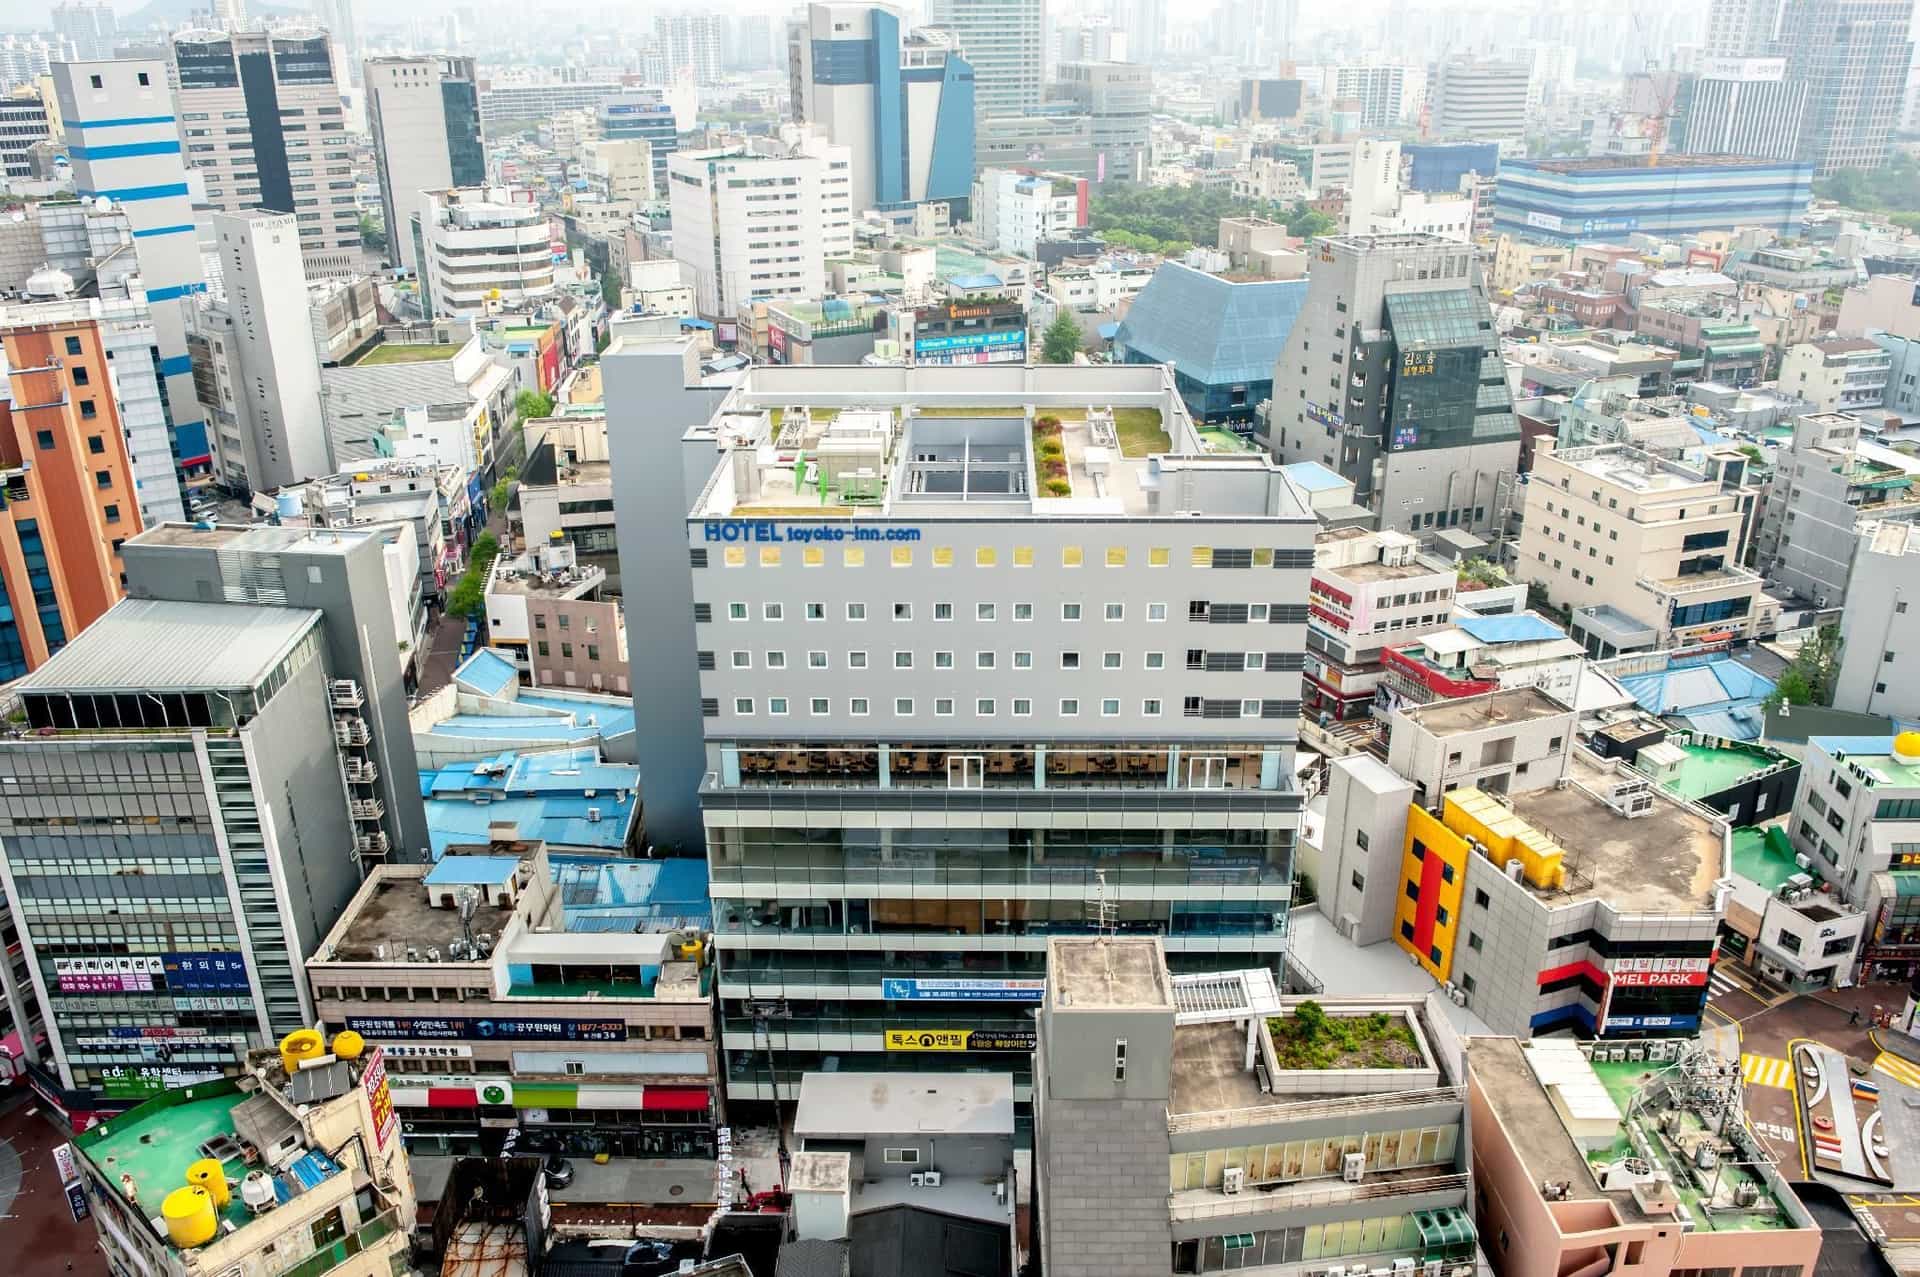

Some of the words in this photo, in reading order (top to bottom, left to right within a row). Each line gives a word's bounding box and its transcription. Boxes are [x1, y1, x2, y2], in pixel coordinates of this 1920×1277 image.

[704, 522, 783, 542] HOTEL
[787, 525, 921, 543] toyoko-inn.com
[1614, 973, 1645, 985] MEL
[1648, 973, 1692, 985] PARK
